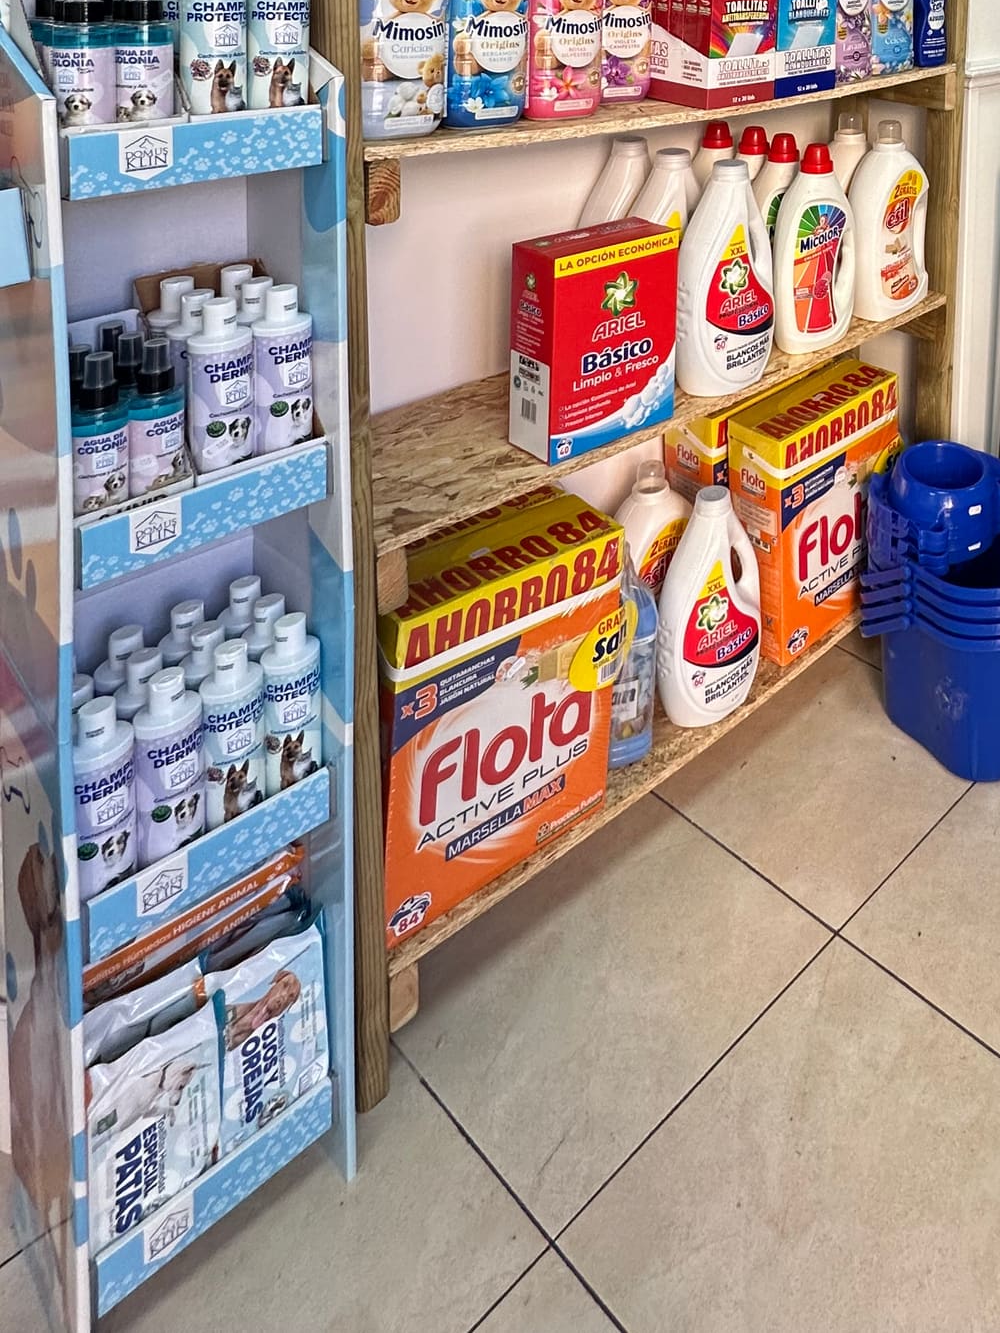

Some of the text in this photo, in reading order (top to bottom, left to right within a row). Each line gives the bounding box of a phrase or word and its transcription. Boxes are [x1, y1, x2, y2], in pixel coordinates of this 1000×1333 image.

[725, 0, 769, 12] TOALLITAS
[372, 16, 445, 43] Mimosin
[466, 15, 529, 41] Mimosin
[545, 15, 602, 37] Mimosin
[606, 29, 643, 41] Origins
[480, 40, 521, 52] Origins
[558, 36, 596, 48] Origins
[784, 46, 832, 65] TOALLITAS
[885, 197, 910, 230] esil
[559, 236, 675, 272] LA OPCIÓN ECONÓMICA
[729, 246, 745, 257] XXL
[720, 290, 758, 313] ARIEL
[737, 303, 770, 328] Básico
[591, 311, 646, 343] ARIEL
[581, 337, 652, 377] Básico
[726, 341, 759, 363] BLANCOS
[572, 354, 659, 393] Limpio & Fresco
[756, 366, 889, 441] AHORRO 84
[784, 378, 898, 470] AHORRO 84
[77, 437, 129, 456] COLONIA
[83, 434, 111, 448] AGUA
[558, 447, 570, 456] 40
[676, 443, 700, 466] Flota
[740, 468, 766, 493] Flota
[784, 483, 806, 510] x3
[546, 510, 610, 546] 84
[707, 582, 723, 594] XXL
[798, 552, 850, 599] ACTIVE
[403, 537, 621, 670] AHORRO 84
[697, 620, 739, 651] ARIEL
[716, 627, 752, 661] Básico
[439, 654, 496, 687] QUITAMANCHAS
[439, 672, 478, 697] BLANCURA
[704, 669, 741, 697] BLANCOS
[400, 682, 439, 721] x3
[439, 673, 496, 707] JABÓN NATURAL
[418, 690, 594, 827] Flota
[416, 738, 589, 851] ACTIVE PLUS
[448, 776, 563, 858] MARSELLA MAX
[172, 903, 217, 935] HIGIENE
[217, 878, 259, 909] ANIMAL
[398, 914, 420, 933] 84
[261, 1021, 279, 1073] OJOS
[241, 1034, 265, 1125] OREJAS
[142, 1122, 158, 1199] ESPECIAL
[114, 1135, 143, 1235] PATAS
